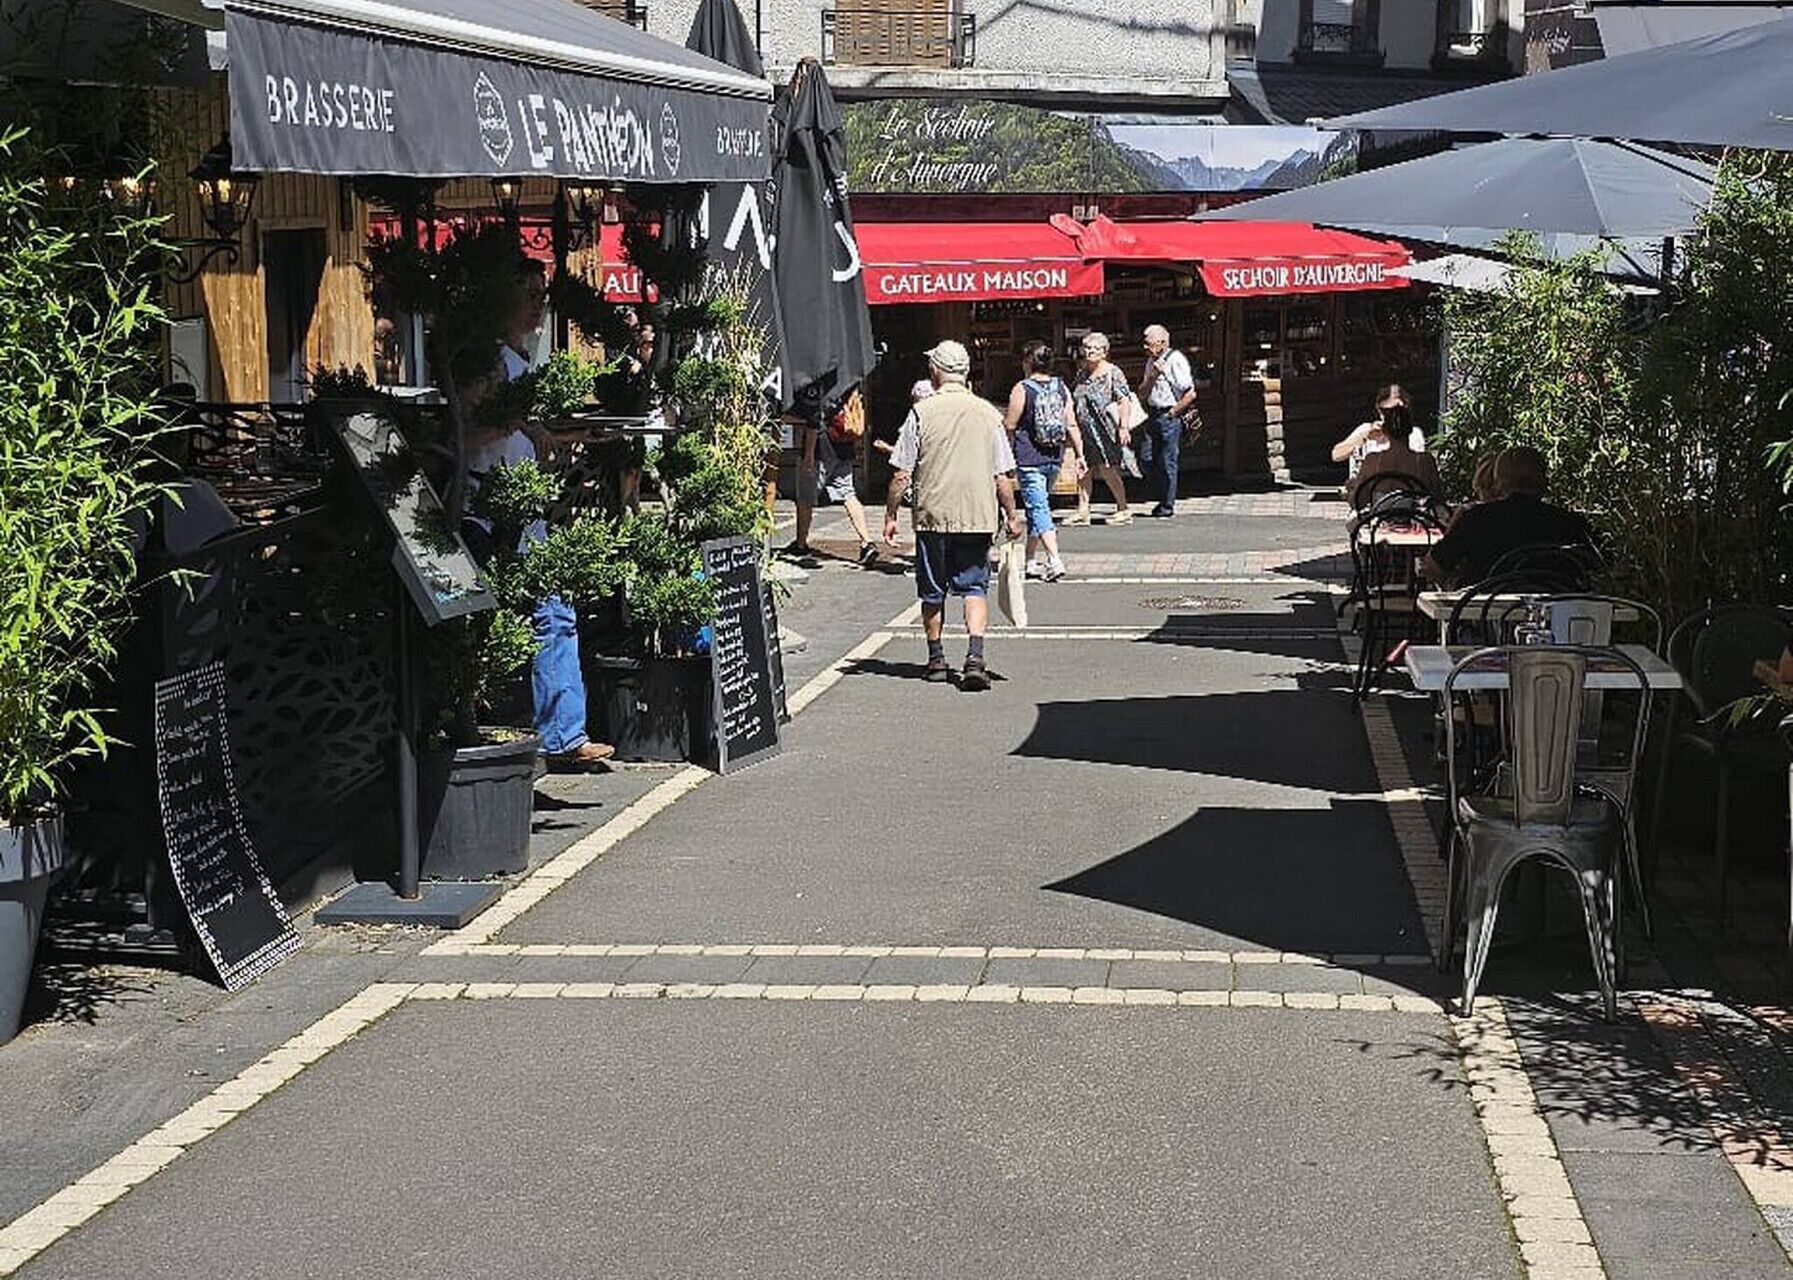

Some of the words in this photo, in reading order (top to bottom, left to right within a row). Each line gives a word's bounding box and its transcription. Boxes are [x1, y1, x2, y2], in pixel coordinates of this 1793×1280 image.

[265, 74, 395, 132] BRASSERIE
[517, 93, 554, 168] LE
[879, 107, 910, 139] Le
[915, 104, 996, 140] Séchoir
[879, 272, 978, 295] GATEAUX
[982, 268, 1067, 292] MAISON
[1223, 267, 1290, 290] SECHOIR
[1293, 263, 1387, 286] D'AUVERGNE
